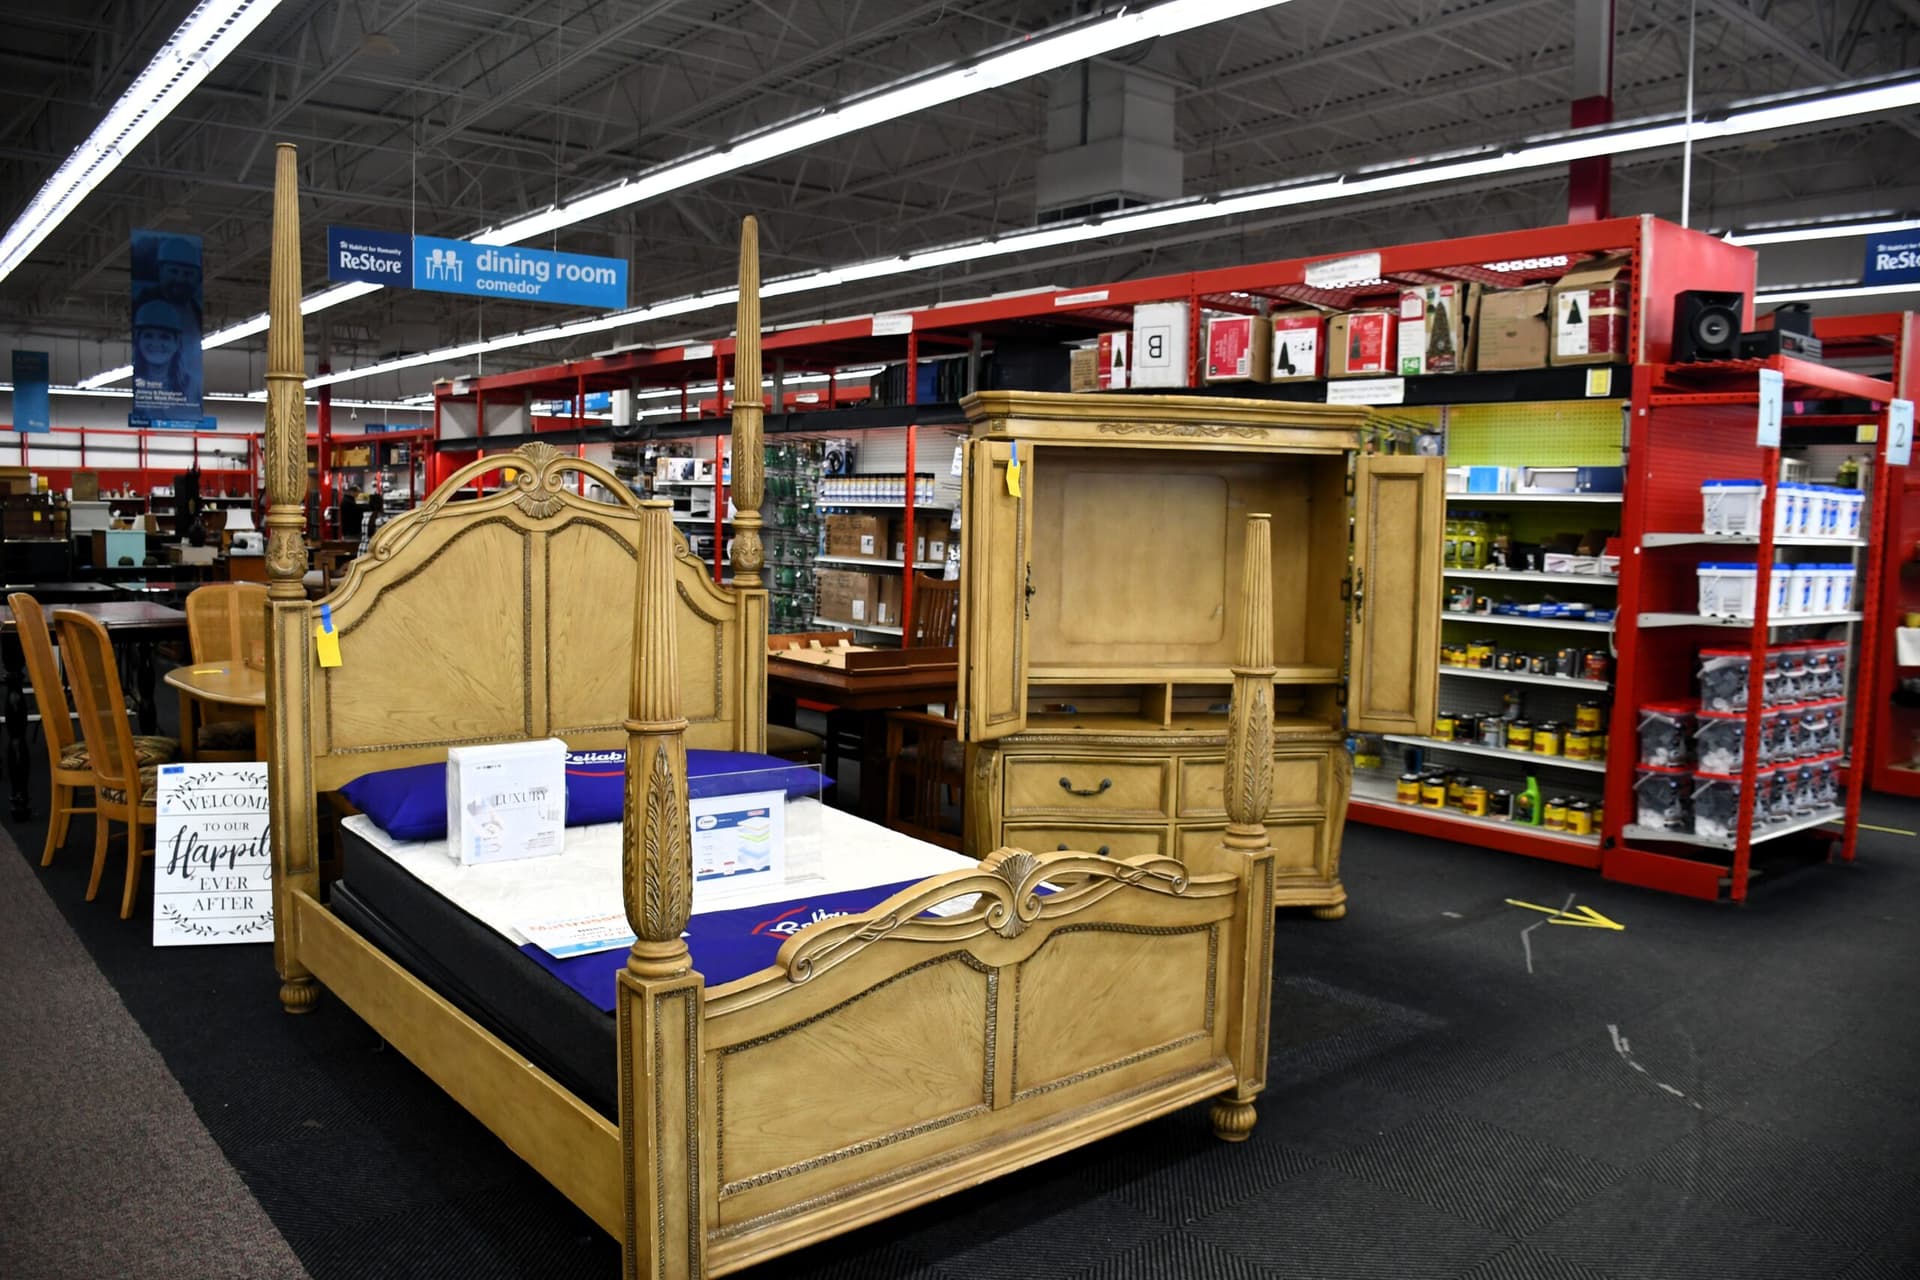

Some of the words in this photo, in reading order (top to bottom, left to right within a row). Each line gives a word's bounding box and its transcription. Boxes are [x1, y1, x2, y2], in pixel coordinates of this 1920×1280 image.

[340, 251, 402, 274] ReStore
[476, 250, 550, 282] dining
[556, 262, 617, 285] room
[476, 278, 542, 295] comedor
[1148, 334, 1162, 358] B
[1768, 398, 1775, 427] 1
[1895, 423, 1906, 448] 2
[495, 790, 548, 806] LUXURY
[202, 822, 220, 832] TO
[224, 821, 250, 832] OUR
[200, 877, 248, 890] EVER
[193, 896, 254, 912] AFTER
